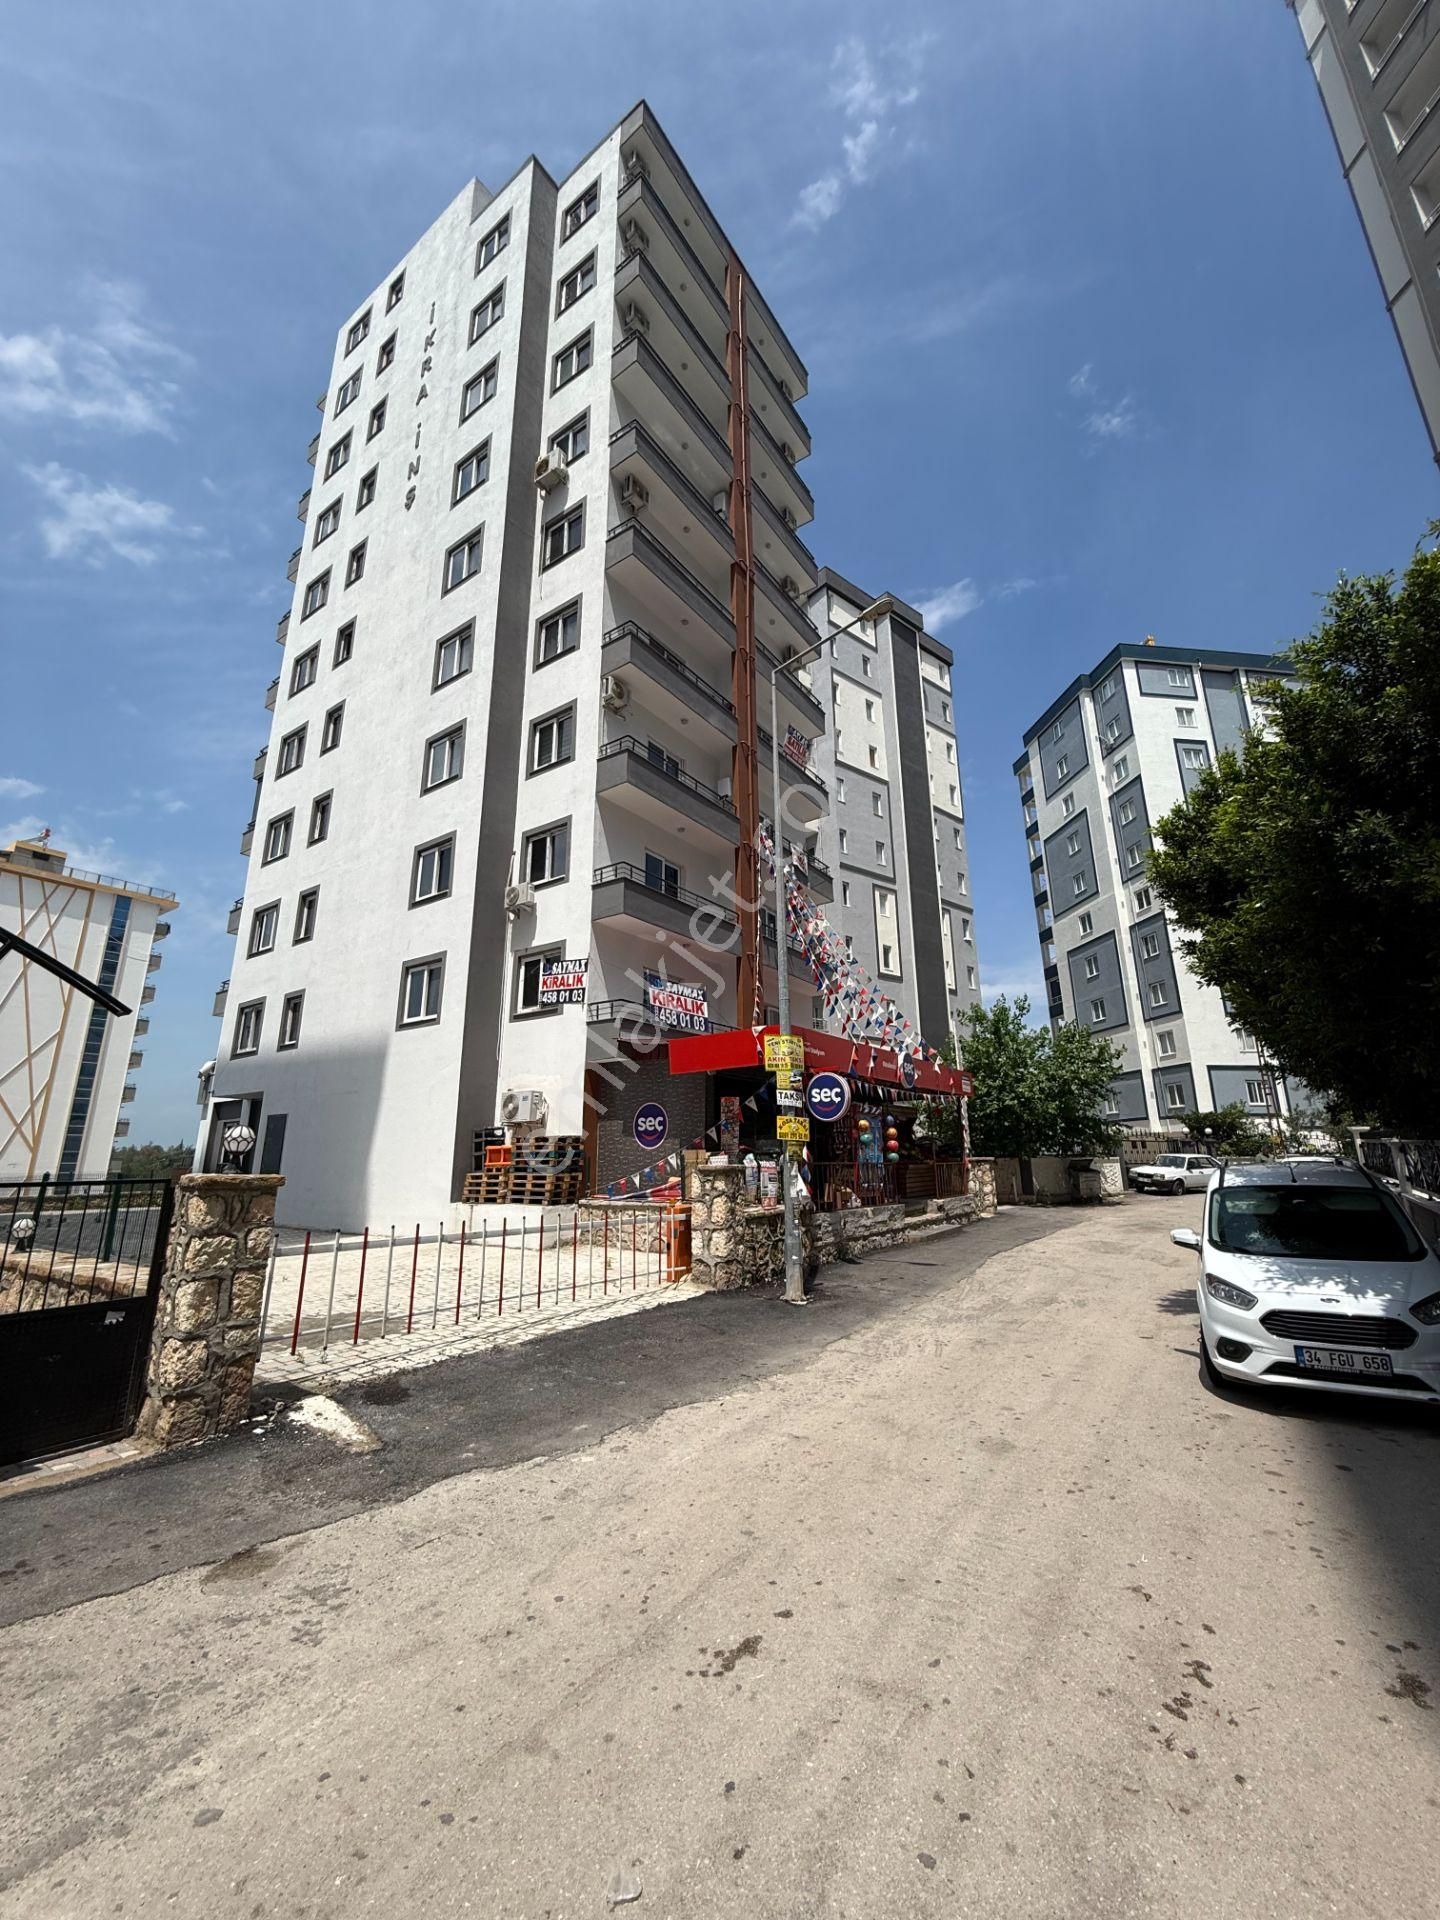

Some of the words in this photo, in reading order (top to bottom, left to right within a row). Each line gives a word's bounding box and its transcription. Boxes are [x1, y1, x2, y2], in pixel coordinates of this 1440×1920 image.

[552, 959, 588, 975] SAYMAX
[542, 991, 558, 1003] 458
[559, 990, 570, 1002] 01
[572, 989, 583, 1002] 03
[665, 981, 705, 1001] SAYMAX
[659, 1007, 678, 1026] 458
[680, 1012, 691, 1028] 01
[693, 1015, 705, 1031] 03
[811, 1087, 842, 1104] seç
[637, 1116, 664, 1132] seç
[1304, 1350, 1321, 1364] 34
[1328, 1352, 1355, 1368] FGU
[1362, 1356, 1389, 1371] 658
